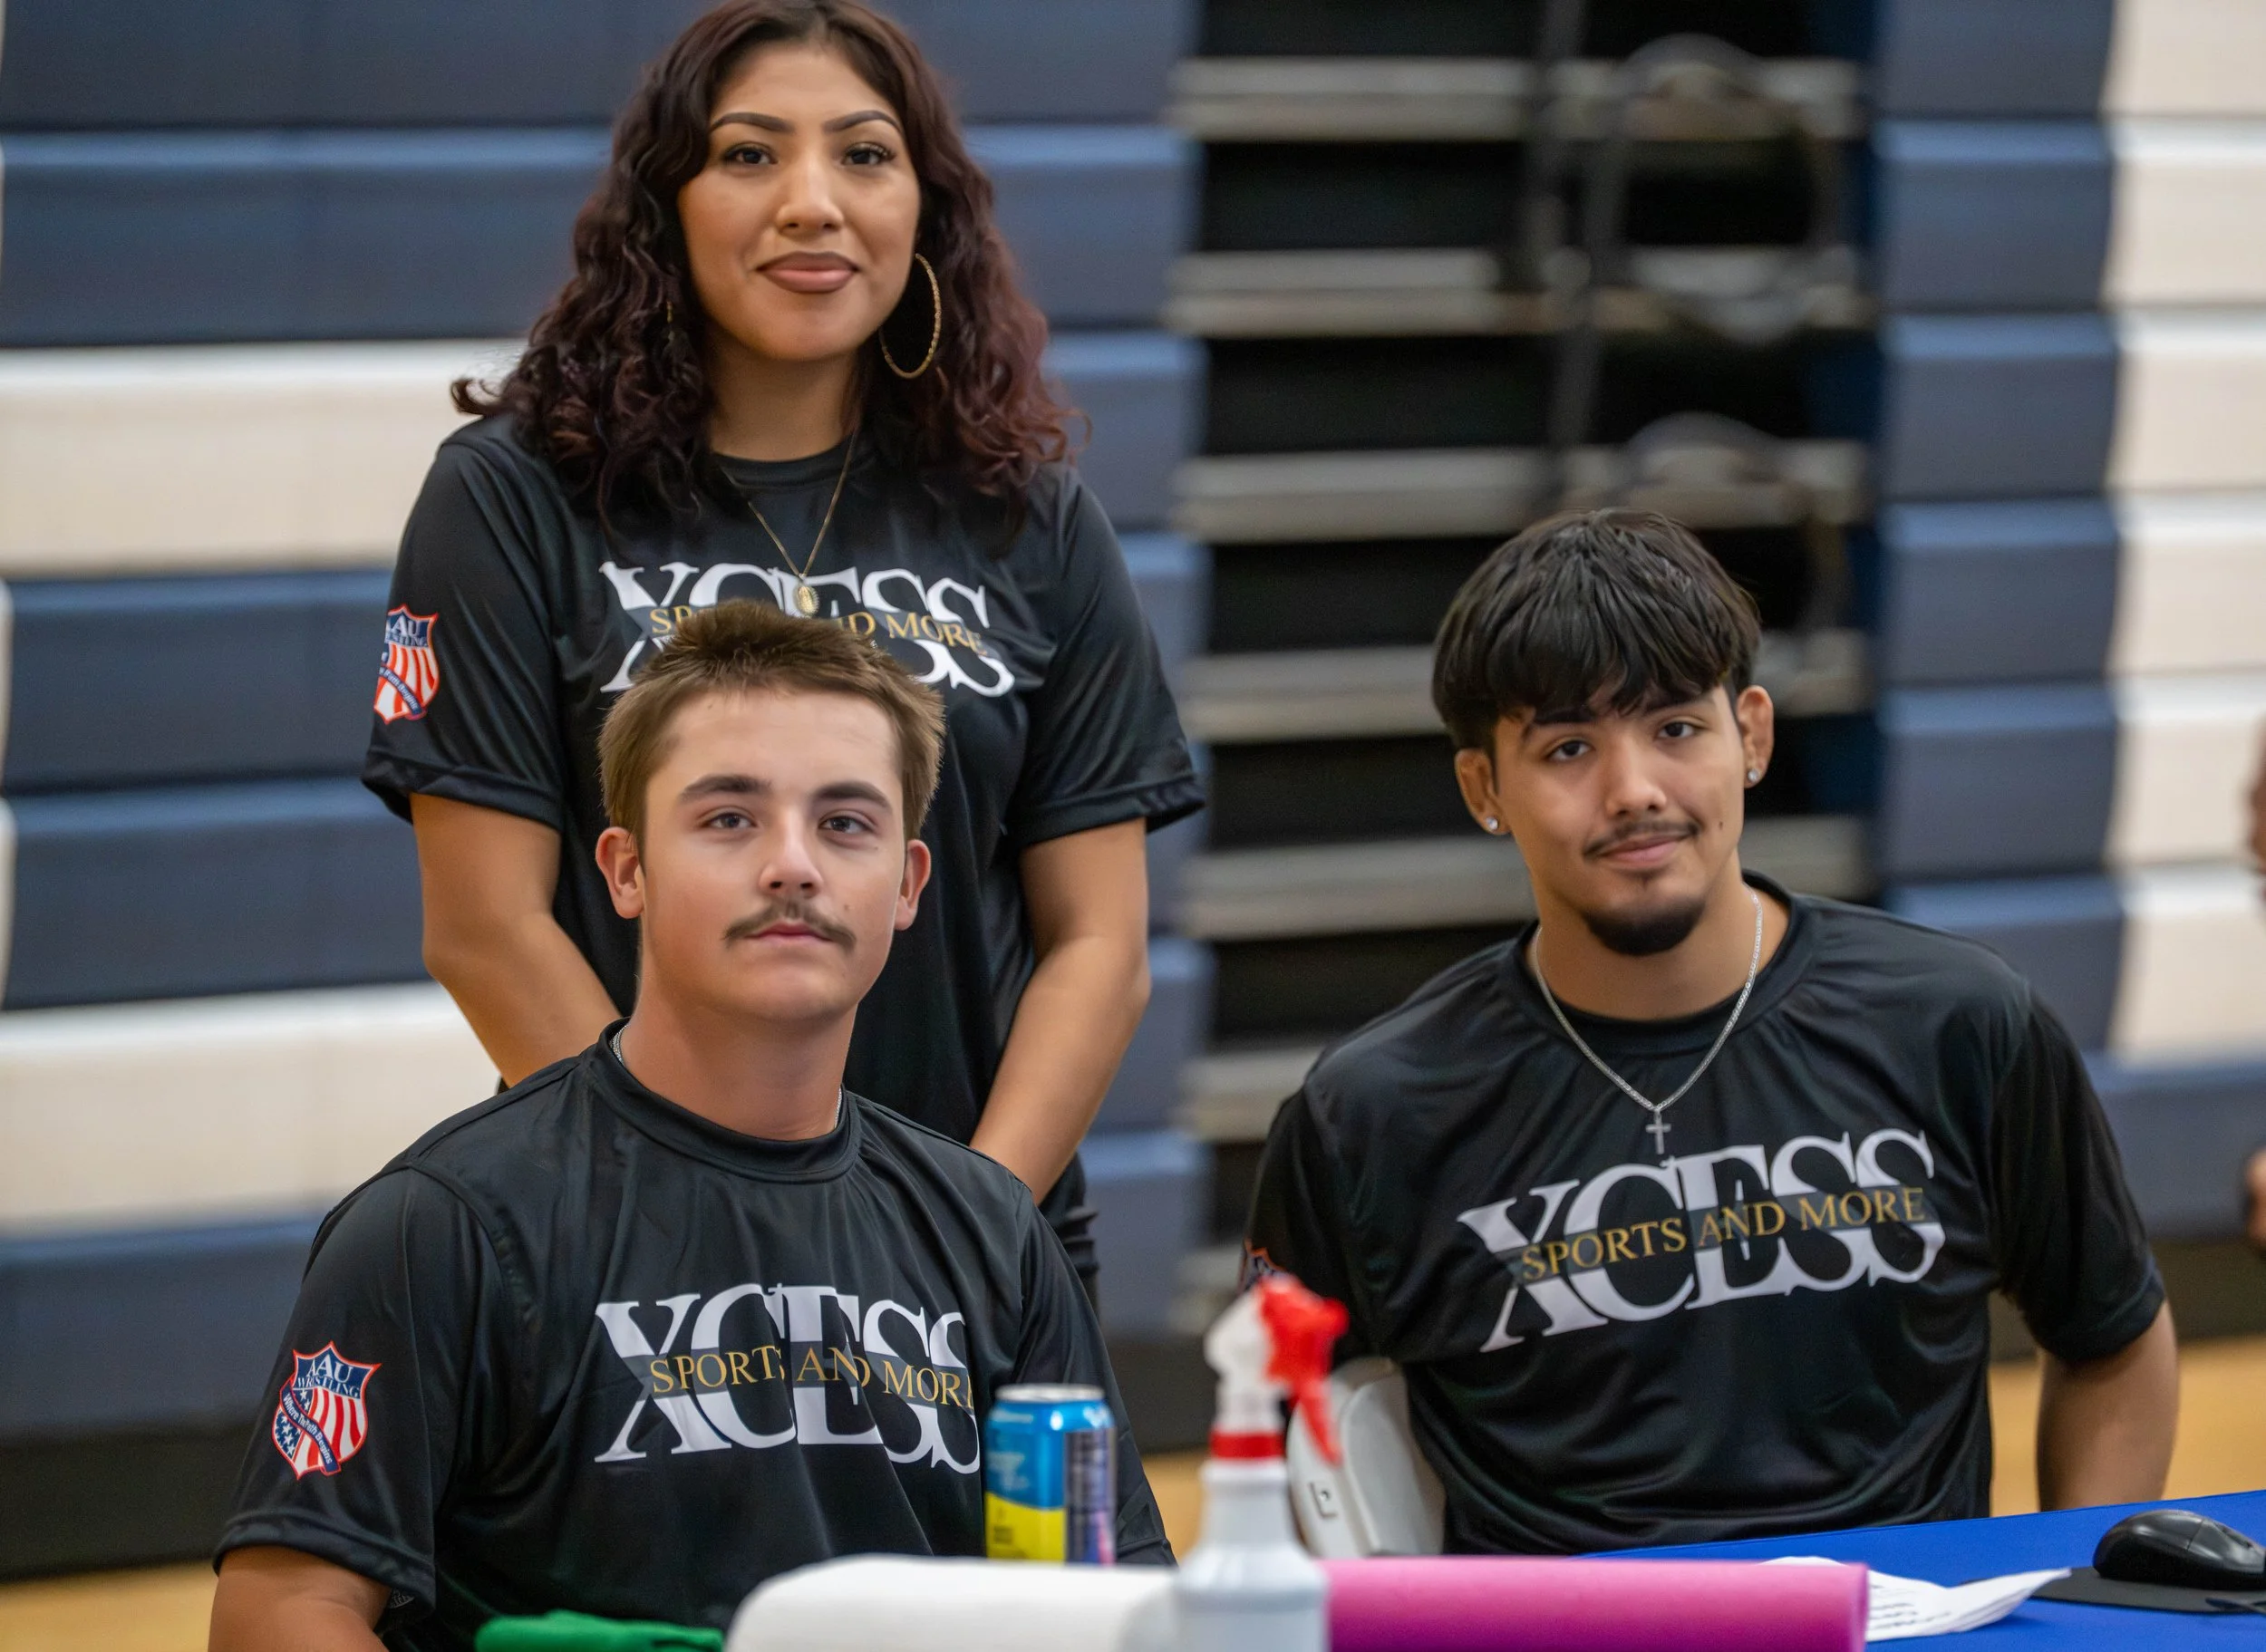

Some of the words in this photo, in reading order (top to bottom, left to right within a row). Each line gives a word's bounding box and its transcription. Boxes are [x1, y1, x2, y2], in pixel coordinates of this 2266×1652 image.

[1457, 1128, 1946, 1353] XCESS
[1521, 1217, 1687, 1281] SPORTS
[1698, 1200, 1787, 1249] AND
[1798, 1187, 1926, 1232] MORE
[306, 1354, 353, 1383] AAU
[595, 1283, 981, 1474] XCESS
[796, 1346, 871, 1388] AND
[283, 1393, 300, 1420] Where
